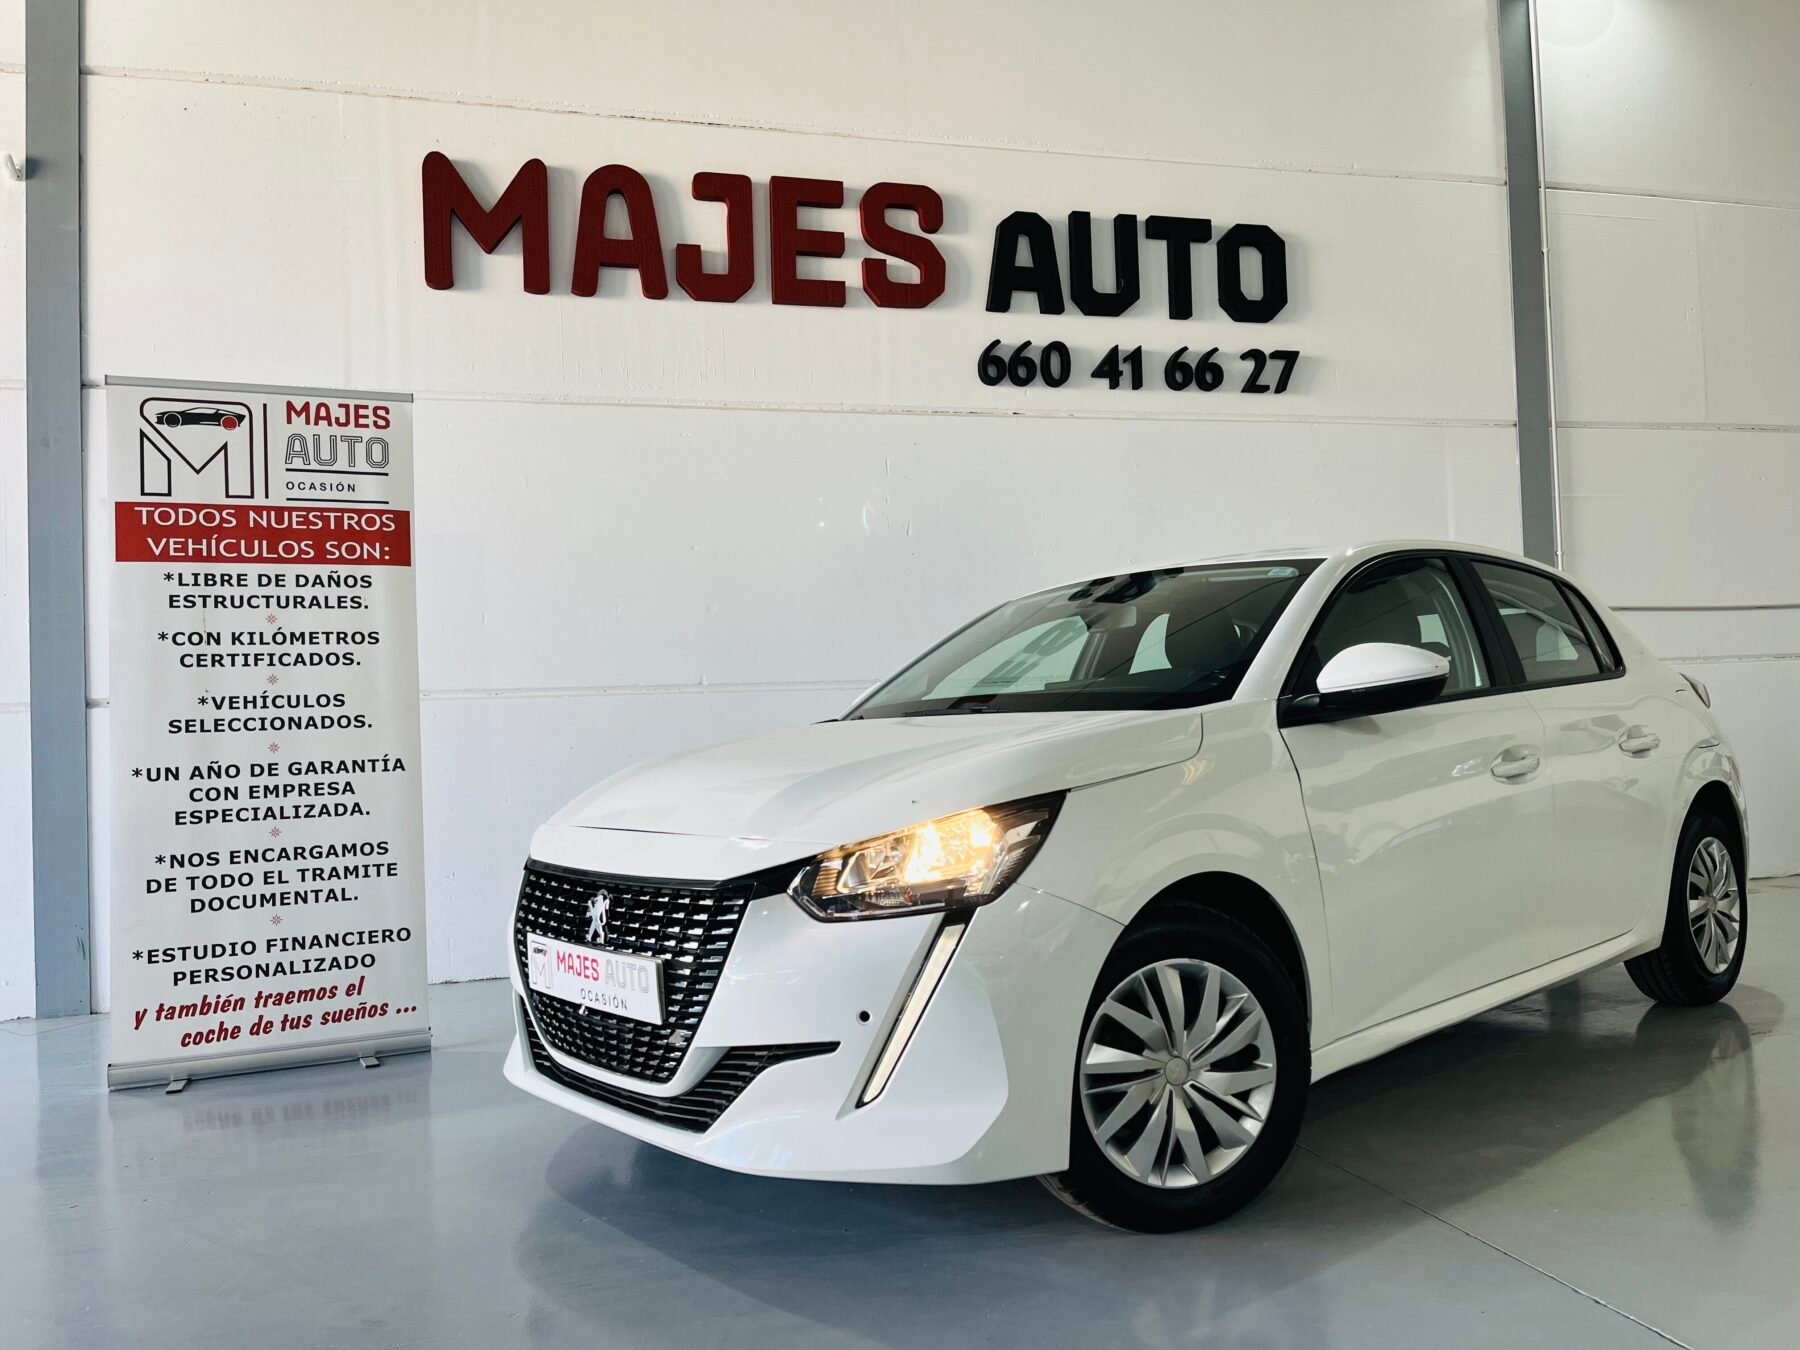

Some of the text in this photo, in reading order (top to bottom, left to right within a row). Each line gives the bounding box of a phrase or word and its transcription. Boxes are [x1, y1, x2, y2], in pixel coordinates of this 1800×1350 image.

[422, 151, 1288, 323] MAJES AUTO
[978, 339, 1300, 394] 660 41 66 27
[286, 400, 391, 429] MAJES
[285, 433, 389, 469] AUTO
[286, 482, 355, 492] OCASIÓN
[134, 507, 396, 531] TODOS NUESTROS
[147, 534, 389, 559] VEHÍCULOS SON:
[258, 574, 286, 587] DE
[296, 571, 372, 588] DAÑOS
[169, 595, 368, 609] ESTRUCTURALES.
[232, 627, 379, 645] KILÓMETROS
[180, 652, 360, 668] CERTIFICADOS.
[169, 715, 372, 734] SELECCIONADOS.
[189, 761, 240, 780] AÑO
[250, 763, 279, 777] DE
[288, 754, 405, 776] GARANTÍA
[189, 781, 355, 802] CON EMPRESA
[175, 801, 370, 826] ESPECIALIZADA.
[230, 841, 390, 865] ENCARGAMOS
[147, 863, 397, 893] DE TODO EL TRAMITE
[191, 886, 358, 914] DOCUMENTAL.
[267, 928, 411, 953] FINANCIERO
[172, 953, 375, 987] PERSONALIZADO
[557, 950, 650, 993] MAJES AUTO
[134, 976, 365, 1030] y también traemos el
[580, 988, 628, 1010] OCASIÓN
[181, 1025, 241, 1047] coche
[249, 1016, 273, 1036] de
[281, 1014, 312, 1031] tus
[320, 1000, 388, 1025] sueños
